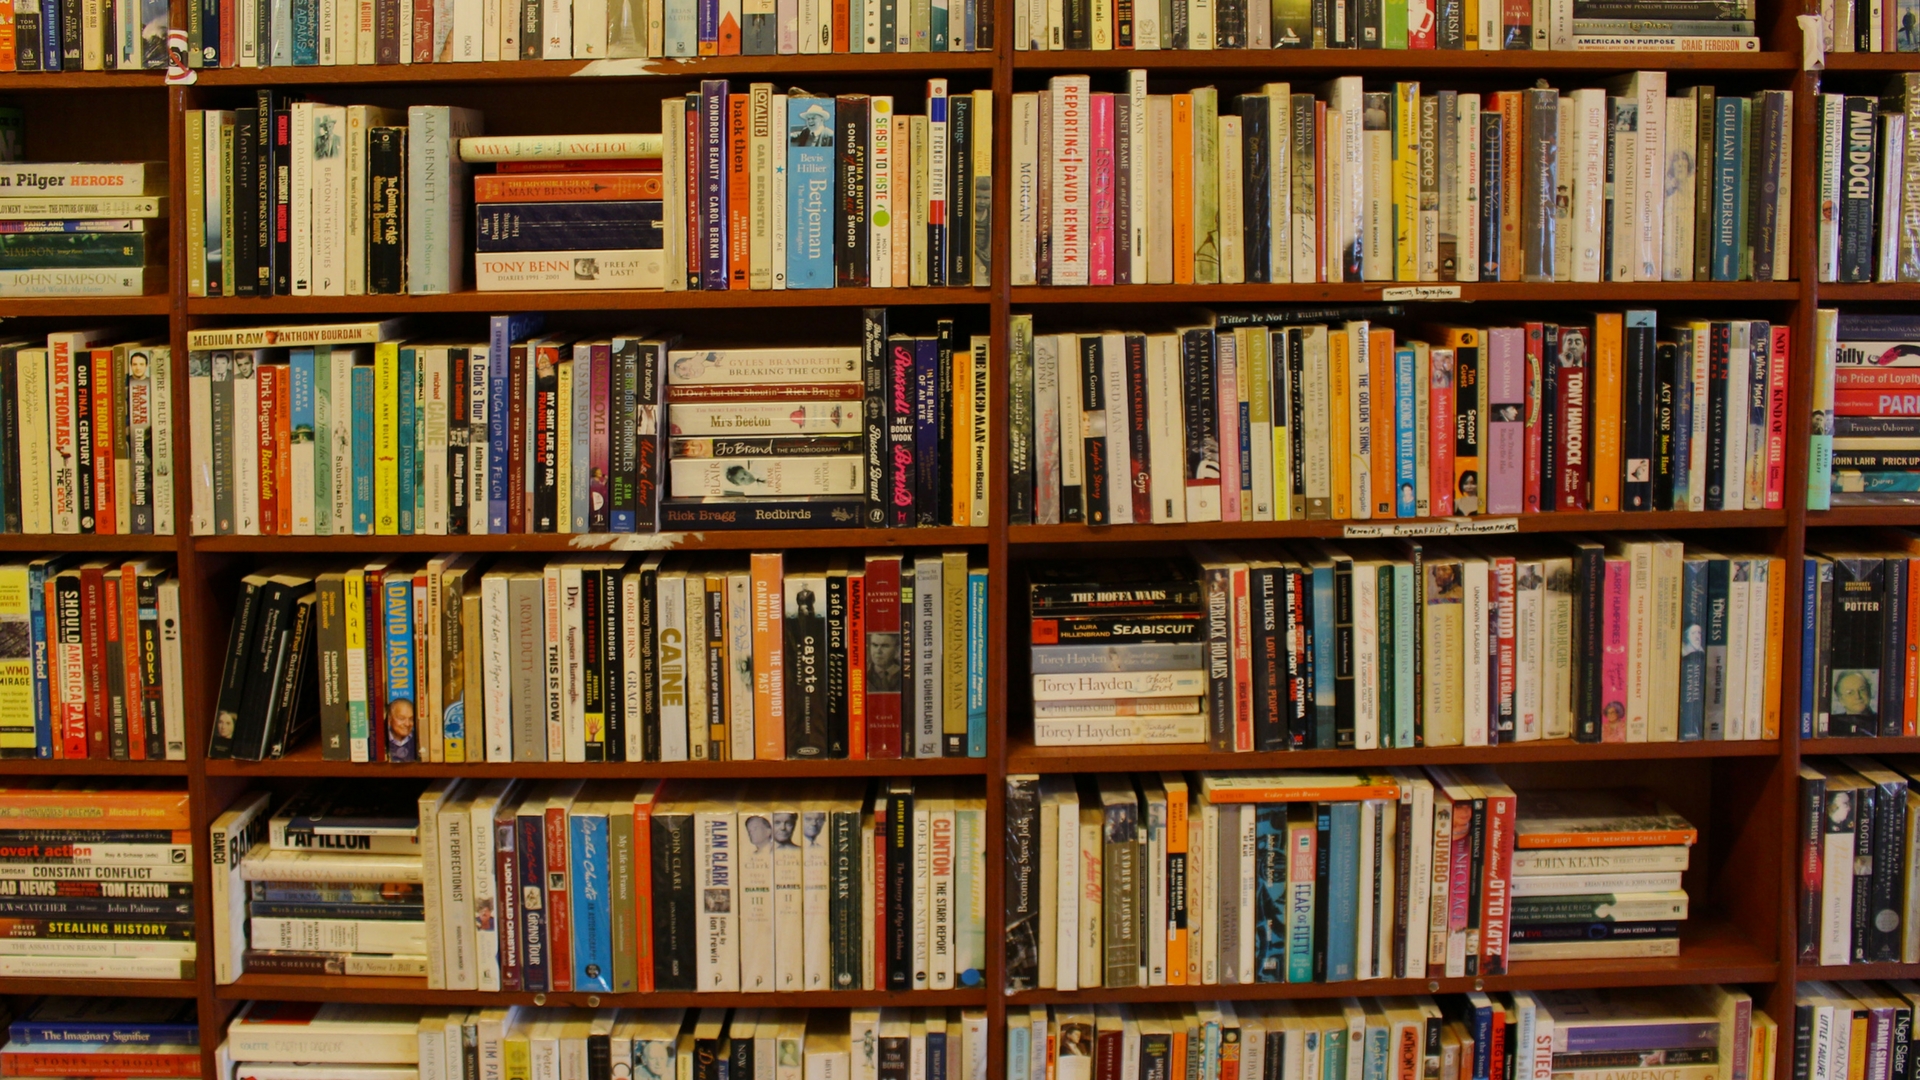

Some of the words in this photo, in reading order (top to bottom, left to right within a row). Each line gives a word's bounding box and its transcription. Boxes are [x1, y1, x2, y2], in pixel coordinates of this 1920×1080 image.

[1682, 40, 1702, 50] CRAIG
[1705, 40, 1740, 51] FERGUSON
[710, 96, 719, 147] WONDROUS
[735, 101, 743, 136] back
[756, 87, 767, 137] LOYALTIES
[1064, 86, 1078, 155] REPORTING
[426, 111, 434, 143] ALAN
[876, 118, 888, 161] SEASON
[1724, 104, 1735, 160] GIULIANI
[475, 146, 510, 156] MAYA
[568, 144, 630, 154] ANGELOU
[800, 154, 824, 163] Bevis
[1848, 111, 1871, 198] MURDOCH
[426, 149, 434, 202] BENNETT
[710, 148, 718, 179] BEAUTY
[798, 164, 826, 172] Hillier
[17, 174, 65, 189] Pilger
[71, 175, 124, 186] HEROES
[847, 166, 855, 196] BLOOD
[876, 172, 887, 200] TASTE
[1064, 166, 1078, 203] DAVID
[710, 197, 718, 224] CAROL
[809, 180, 827, 259] Betjeman
[1722, 167, 1734, 246] LEADERSHIP
[710, 227, 718, 259] BERKIN
[847, 215, 855, 248] SWORD
[1064, 209, 1078, 262] REMNICK
[14, 274, 51, 285] JOHN
[55, 274, 117, 285] SIMPSON
[483, 262, 524, 273] TONY
[530, 261, 569, 272] BENN
[1220, 315, 1248, 324] Titter
[1251, 315, 1264, 323] Ye
[194, 335, 233, 346] MEDIUM
[236, 333, 263, 343] RAW
[279, 330, 320, 342] ANTHONY
[321, 329, 362, 340] BOURDAIN
[54, 342, 69, 384] MARK
[976, 344, 986, 368] THE
[1836, 344, 1864, 364] Billy
[78, 366, 87, 386] OUR
[261, 372, 272, 397] Dirk
[1358, 374, 1368, 390] THE
[1568, 373, 1583, 405] TONY
[78, 388, 88, 418] FINAL
[547, 392, 555, 407] MY
[975, 372, 986, 413] NAKED
[1661, 382, 1672, 404] ACT
[54, 386, 71, 446] THOMAS
[473, 399, 484, 420] Tour
[538, 392, 547, 431] FRANKIE
[547, 409, 555, 430] SHIT
[711, 416, 733, 427] Mrs
[736, 416, 771, 427] Beeton
[1359, 392, 1370, 424] GOLDEN
[1661, 408, 1671, 431] ONE
[258, 400, 272, 446] Bogarde
[975, 415, 986, 442] MAN
[1468, 410, 1476, 445] Second
[1567, 407, 1582, 465] HANCOCK
[79, 420, 90, 466] CENTURY
[538, 434, 546, 463] BOYLE
[546, 432, 554, 451] LIFE
[1360, 427, 1370, 455] STRING
[546, 453, 554, 466] SO
[261, 450, 273, 500] Backcloth
[545, 469, 554, 486] FAR
[756, 509, 811, 520] Redbirds
[1263, 574, 1273, 599] BILL
[1498, 564, 1514, 592] ROY
[756, 580, 768, 632] CANNADINE
[769, 594, 780, 619] DAVID
[831, 593, 840, 615] safe
[1071, 593, 1093, 602] THE
[1096, 592, 1133, 602] HOFFA
[1136, 590, 1166, 600] WARS
[1845, 602, 1879, 611] POTTER
[65, 591, 79, 642] SHOULD
[388, 587, 407, 634] DAVID
[1264, 603, 1274, 630] HICKS
[1498, 597, 1514, 638] HUDD
[830, 620, 840, 648] place
[1113, 625, 1194, 634] SEABISCUIT
[390, 640, 409, 688] JASON
[660, 628, 683, 706] CAINE
[770, 650, 781, 666] THE
[804, 636, 815, 693] capote
[68, 645, 83, 704] AMERICA
[760, 673, 769, 695] PAST
[1039, 678, 1076, 694] Torey
[1079, 677, 1132, 692] Hayden
[771, 670, 781, 717] UNDIVIDED
[70, 705, 84, 738] PAY?
[109, 808, 139, 817] Michael
[141, 808, 164, 816] Pollan
[450, 822, 459, 837] THE
[711, 820, 728, 848] ALAN
[213, 832, 226, 864] BANCO
[932, 819, 951, 876] CLINTON
[1434, 829, 1449, 883] JUMBO
[32, 867, 91, 878] CONSTANT
[96, 868, 152, 878] CONFLICT
[450, 840, 462, 902] PERFECTIONIST
[711, 853, 729, 886] CLARK
[1534, 857, 1566, 868] JOHN
[1569, 856, 1610, 867] KEATS
[100, 882, 124, 897] TOM
[127, 884, 169, 898] FENTON
[936, 881, 947, 897] THE
[1294, 884, 1311, 914] FEAR
[1488, 880, 1504, 916] OTTO
[936, 900, 947, 924] STARR
[49, 922, 108, 934] STEALING
[114, 922, 167, 934] HISTORY
[936, 925, 947, 955] REPORT
[1293, 926, 1311, 955] FIFTY
[1487, 919, 1503, 956] KATZ
[42, 1031, 61, 1040] The
[64, 1031, 110, 1042] Imaginary
[113, 1031, 150, 1042] Signifier
[1820, 1014, 1828, 1041] LITTLE
[1895, 1017, 1910, 1043] Nigel
[1817, 1042, 1828, 1077] FAILURE
[1895, 1045, 1908, 1074] Slater
